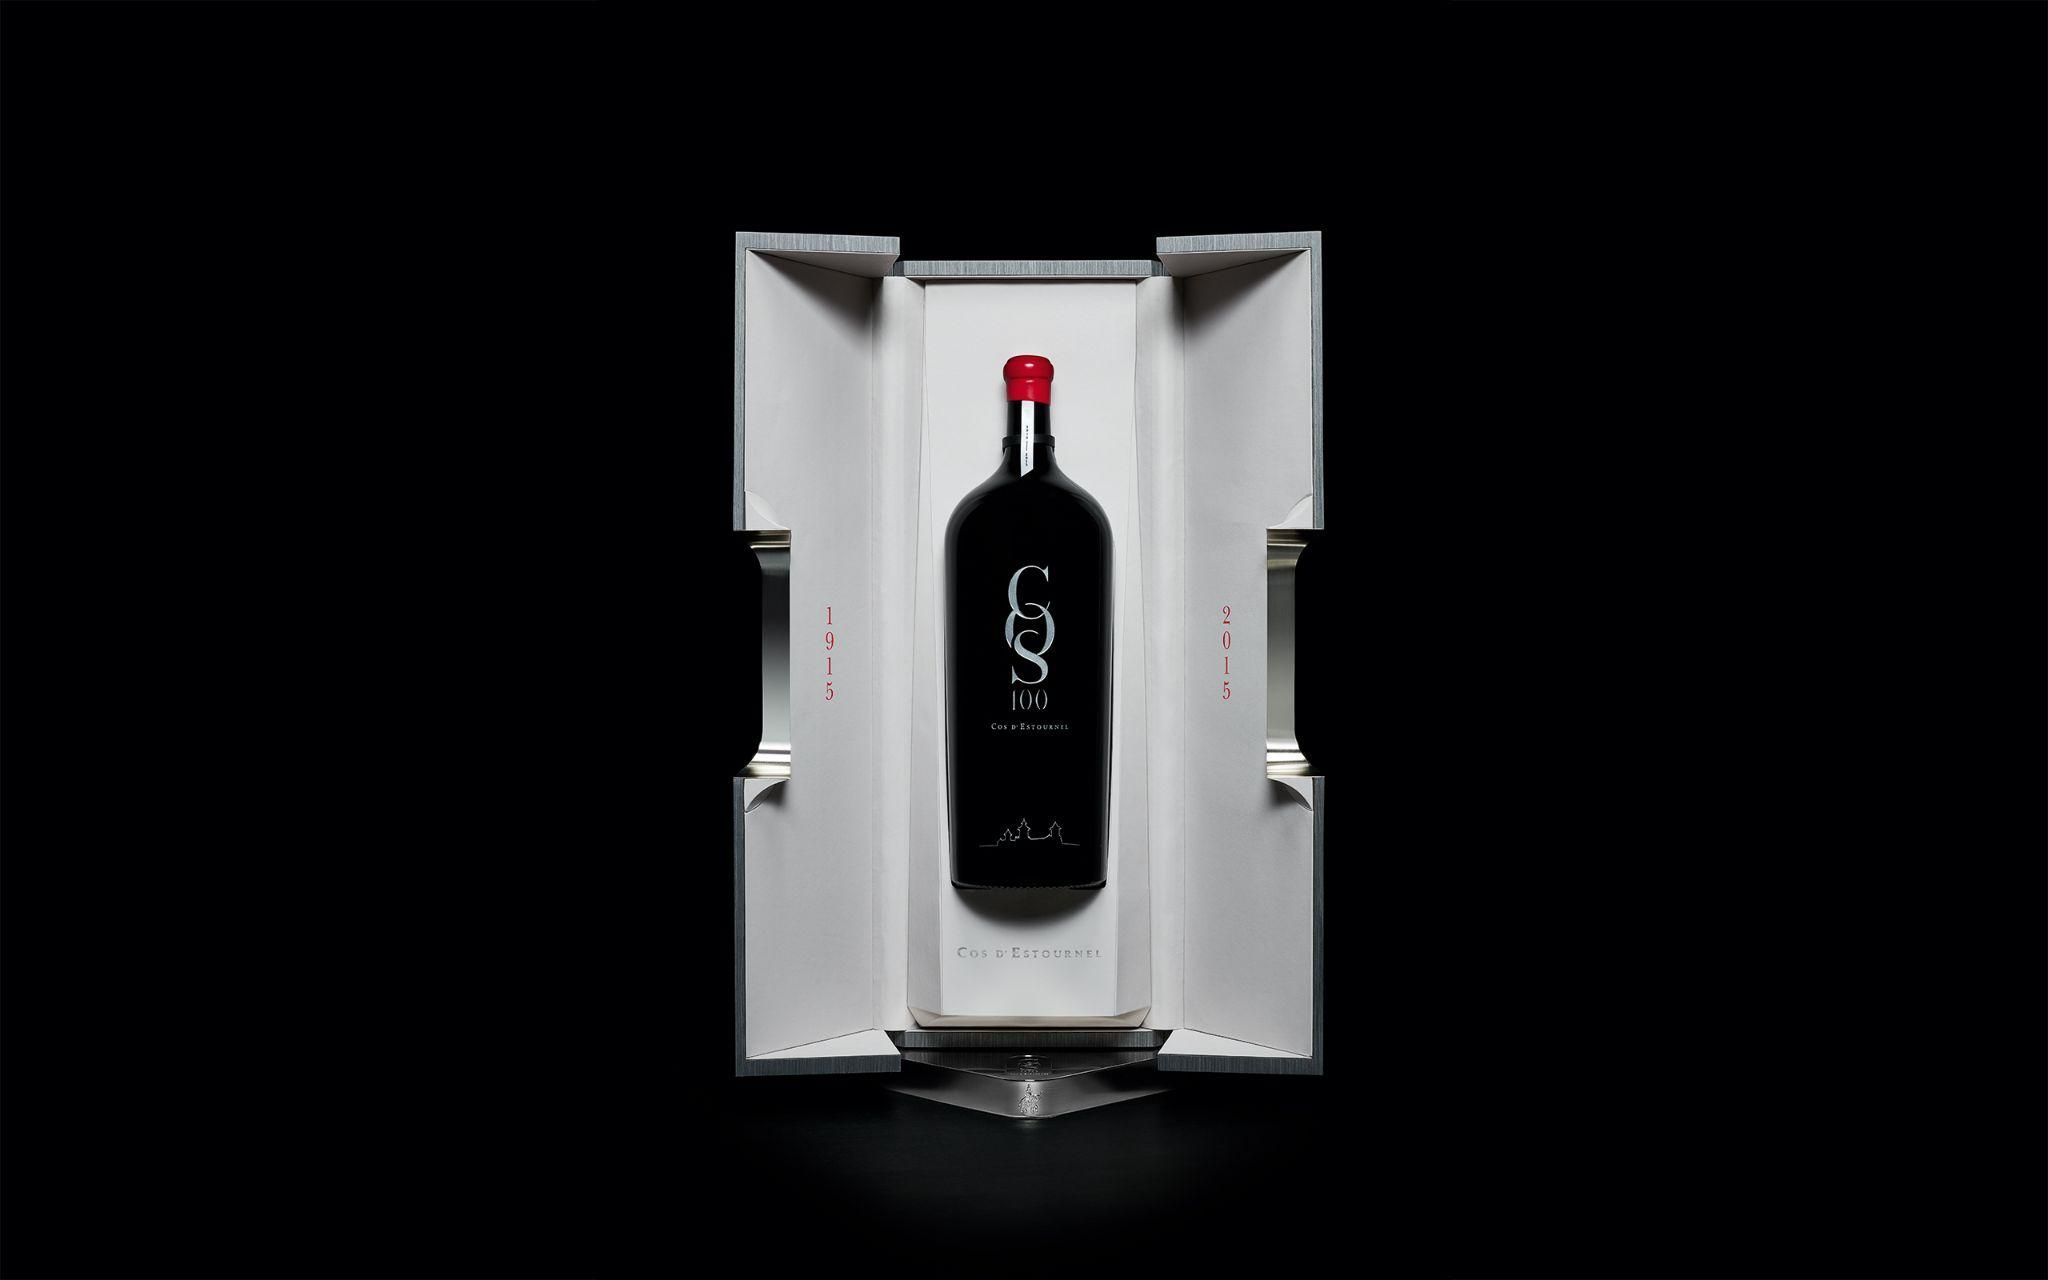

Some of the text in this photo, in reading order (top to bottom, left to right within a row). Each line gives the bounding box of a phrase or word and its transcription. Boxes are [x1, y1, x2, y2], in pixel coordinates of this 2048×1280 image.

[825, 606, 835, 701] 1915
[1005, 565, 1056, 684] COS
[1222, 605, 1231, 700] 2015
[1011, 689, 1048, 711] 100
[956, 946, 988, 959] COS
